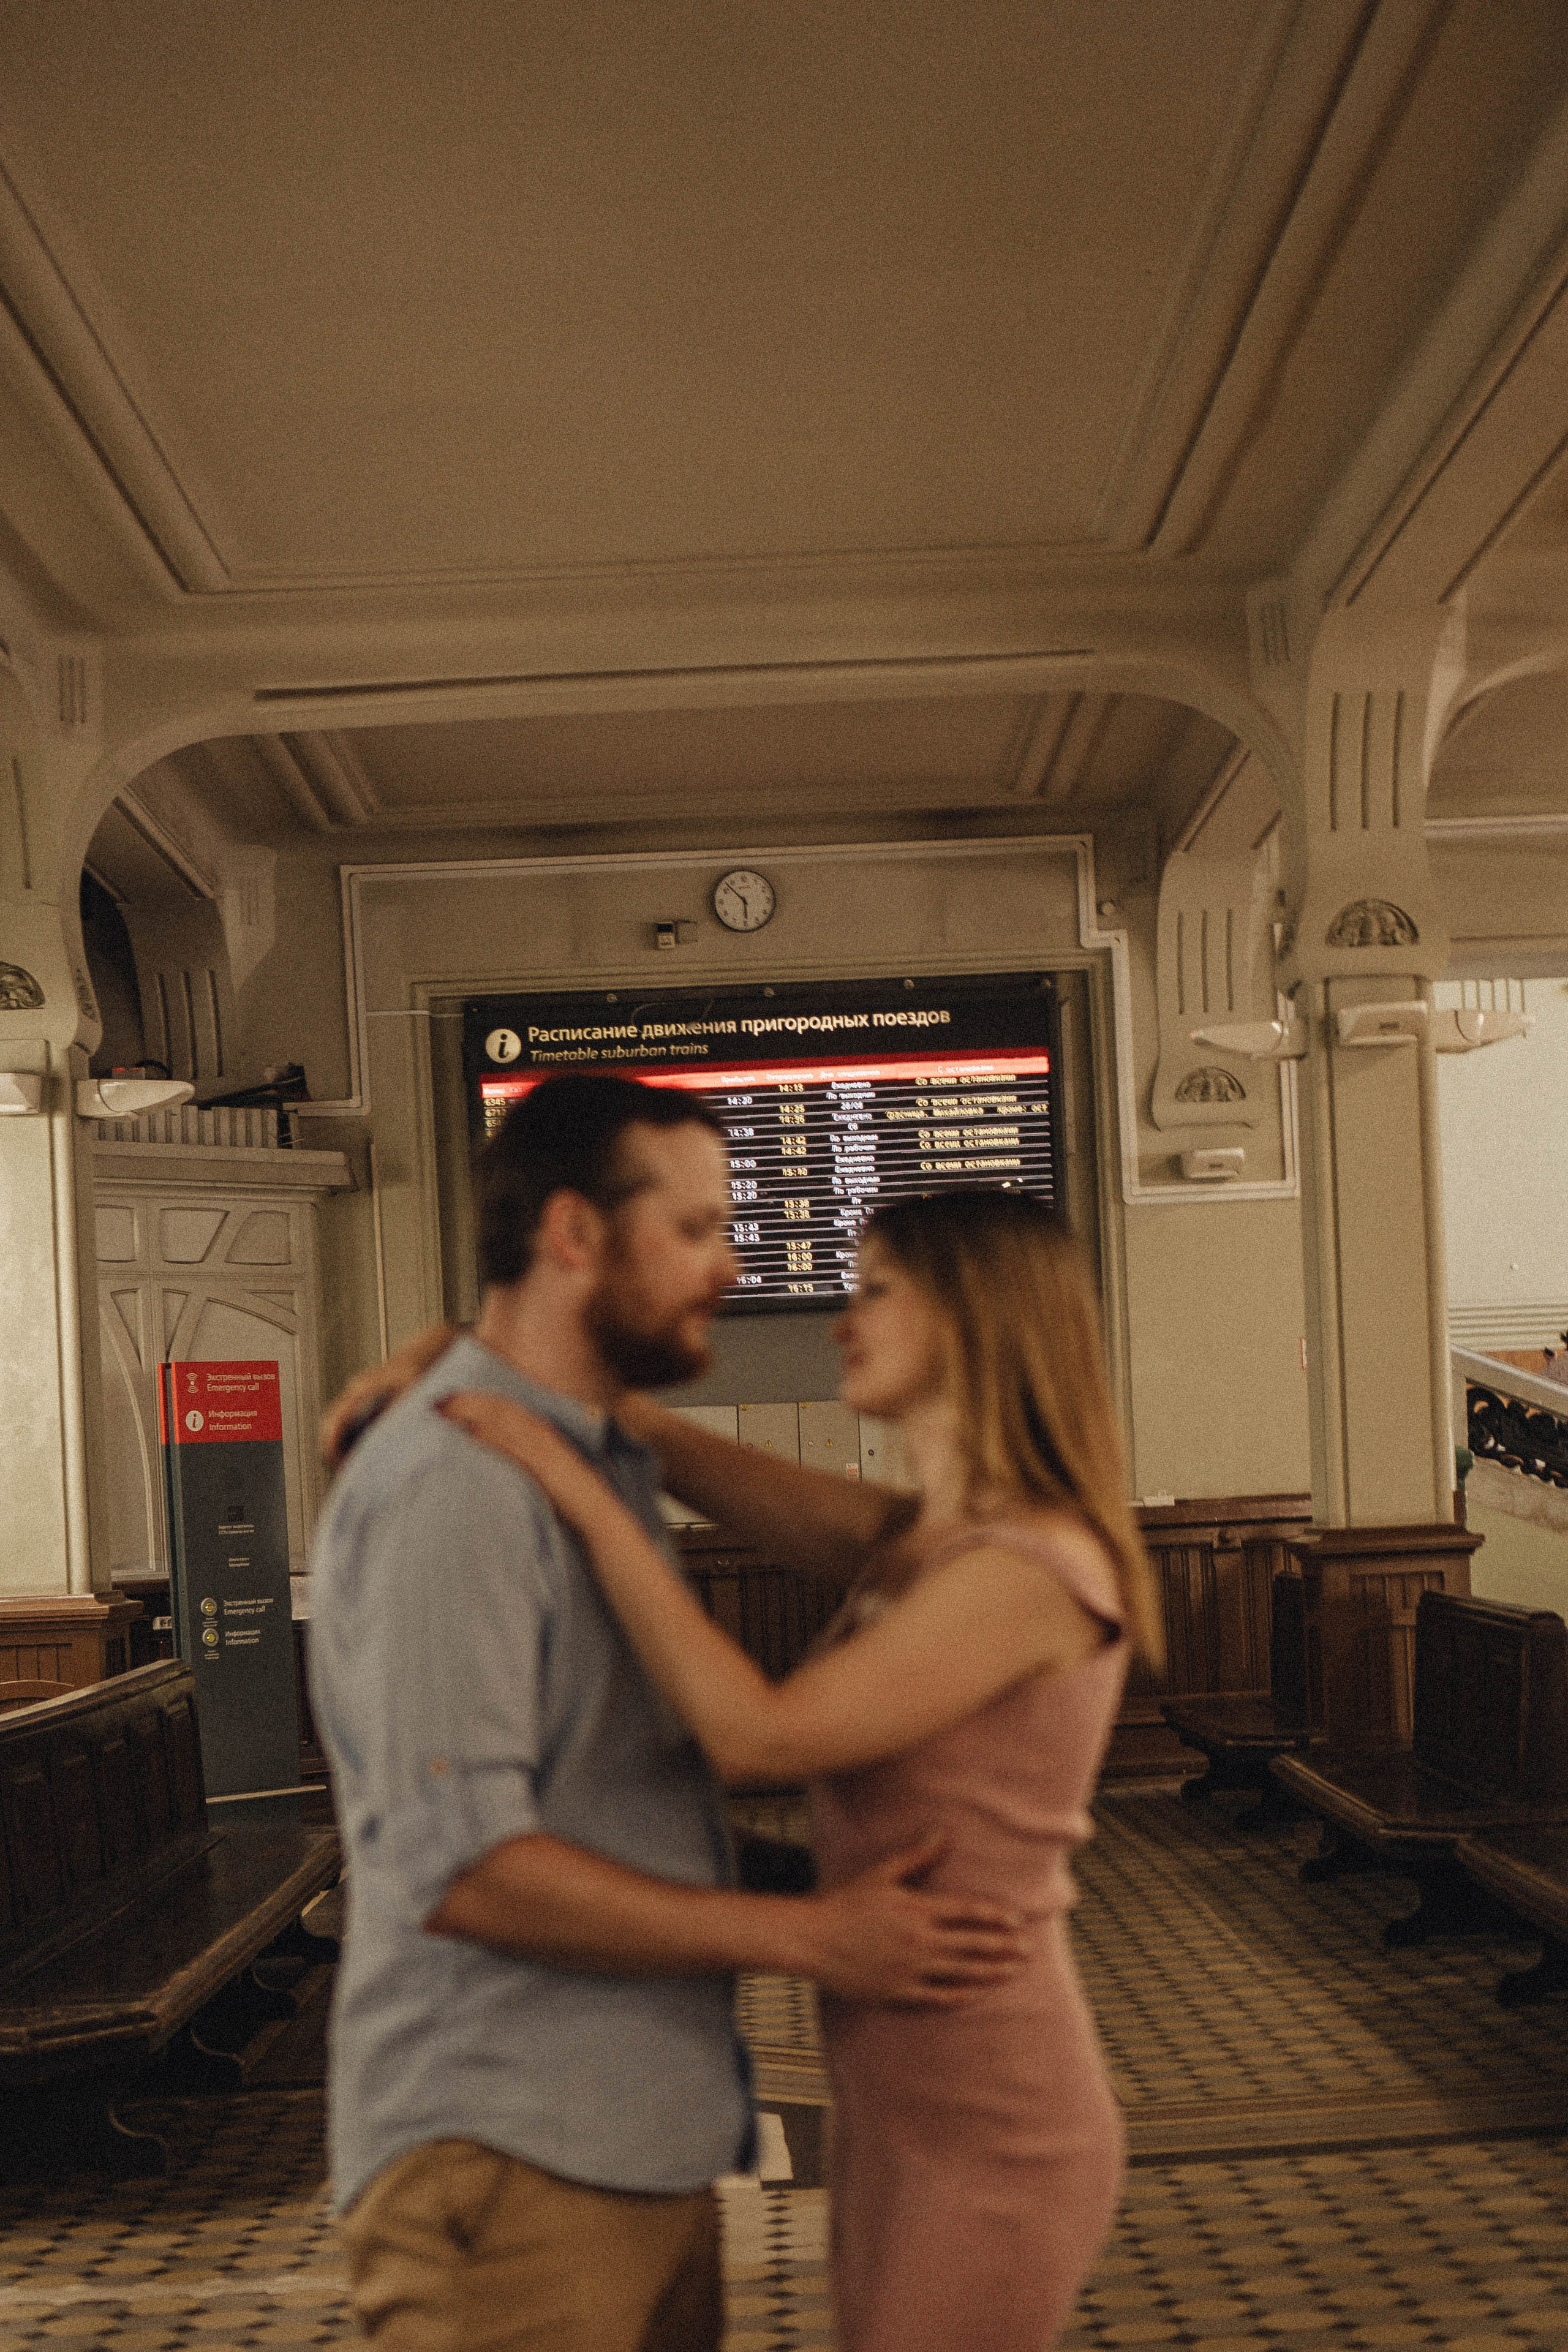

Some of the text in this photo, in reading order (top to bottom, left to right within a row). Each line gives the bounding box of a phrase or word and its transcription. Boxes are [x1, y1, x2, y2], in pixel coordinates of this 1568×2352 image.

[528, 1010, 950, 1042] Расписание движения пригородных поездов
[530, 1042, 709, 1062] Timetable suburban trains
[206, 1373, 251, 1382] Экстренный
[206, 1384, 246, 1393] Emergency
[208, 1410, 258, 1419] Информация
[224, 1607, 255, 1616] Emergency
[225, 1637, 259, 1646] Information
